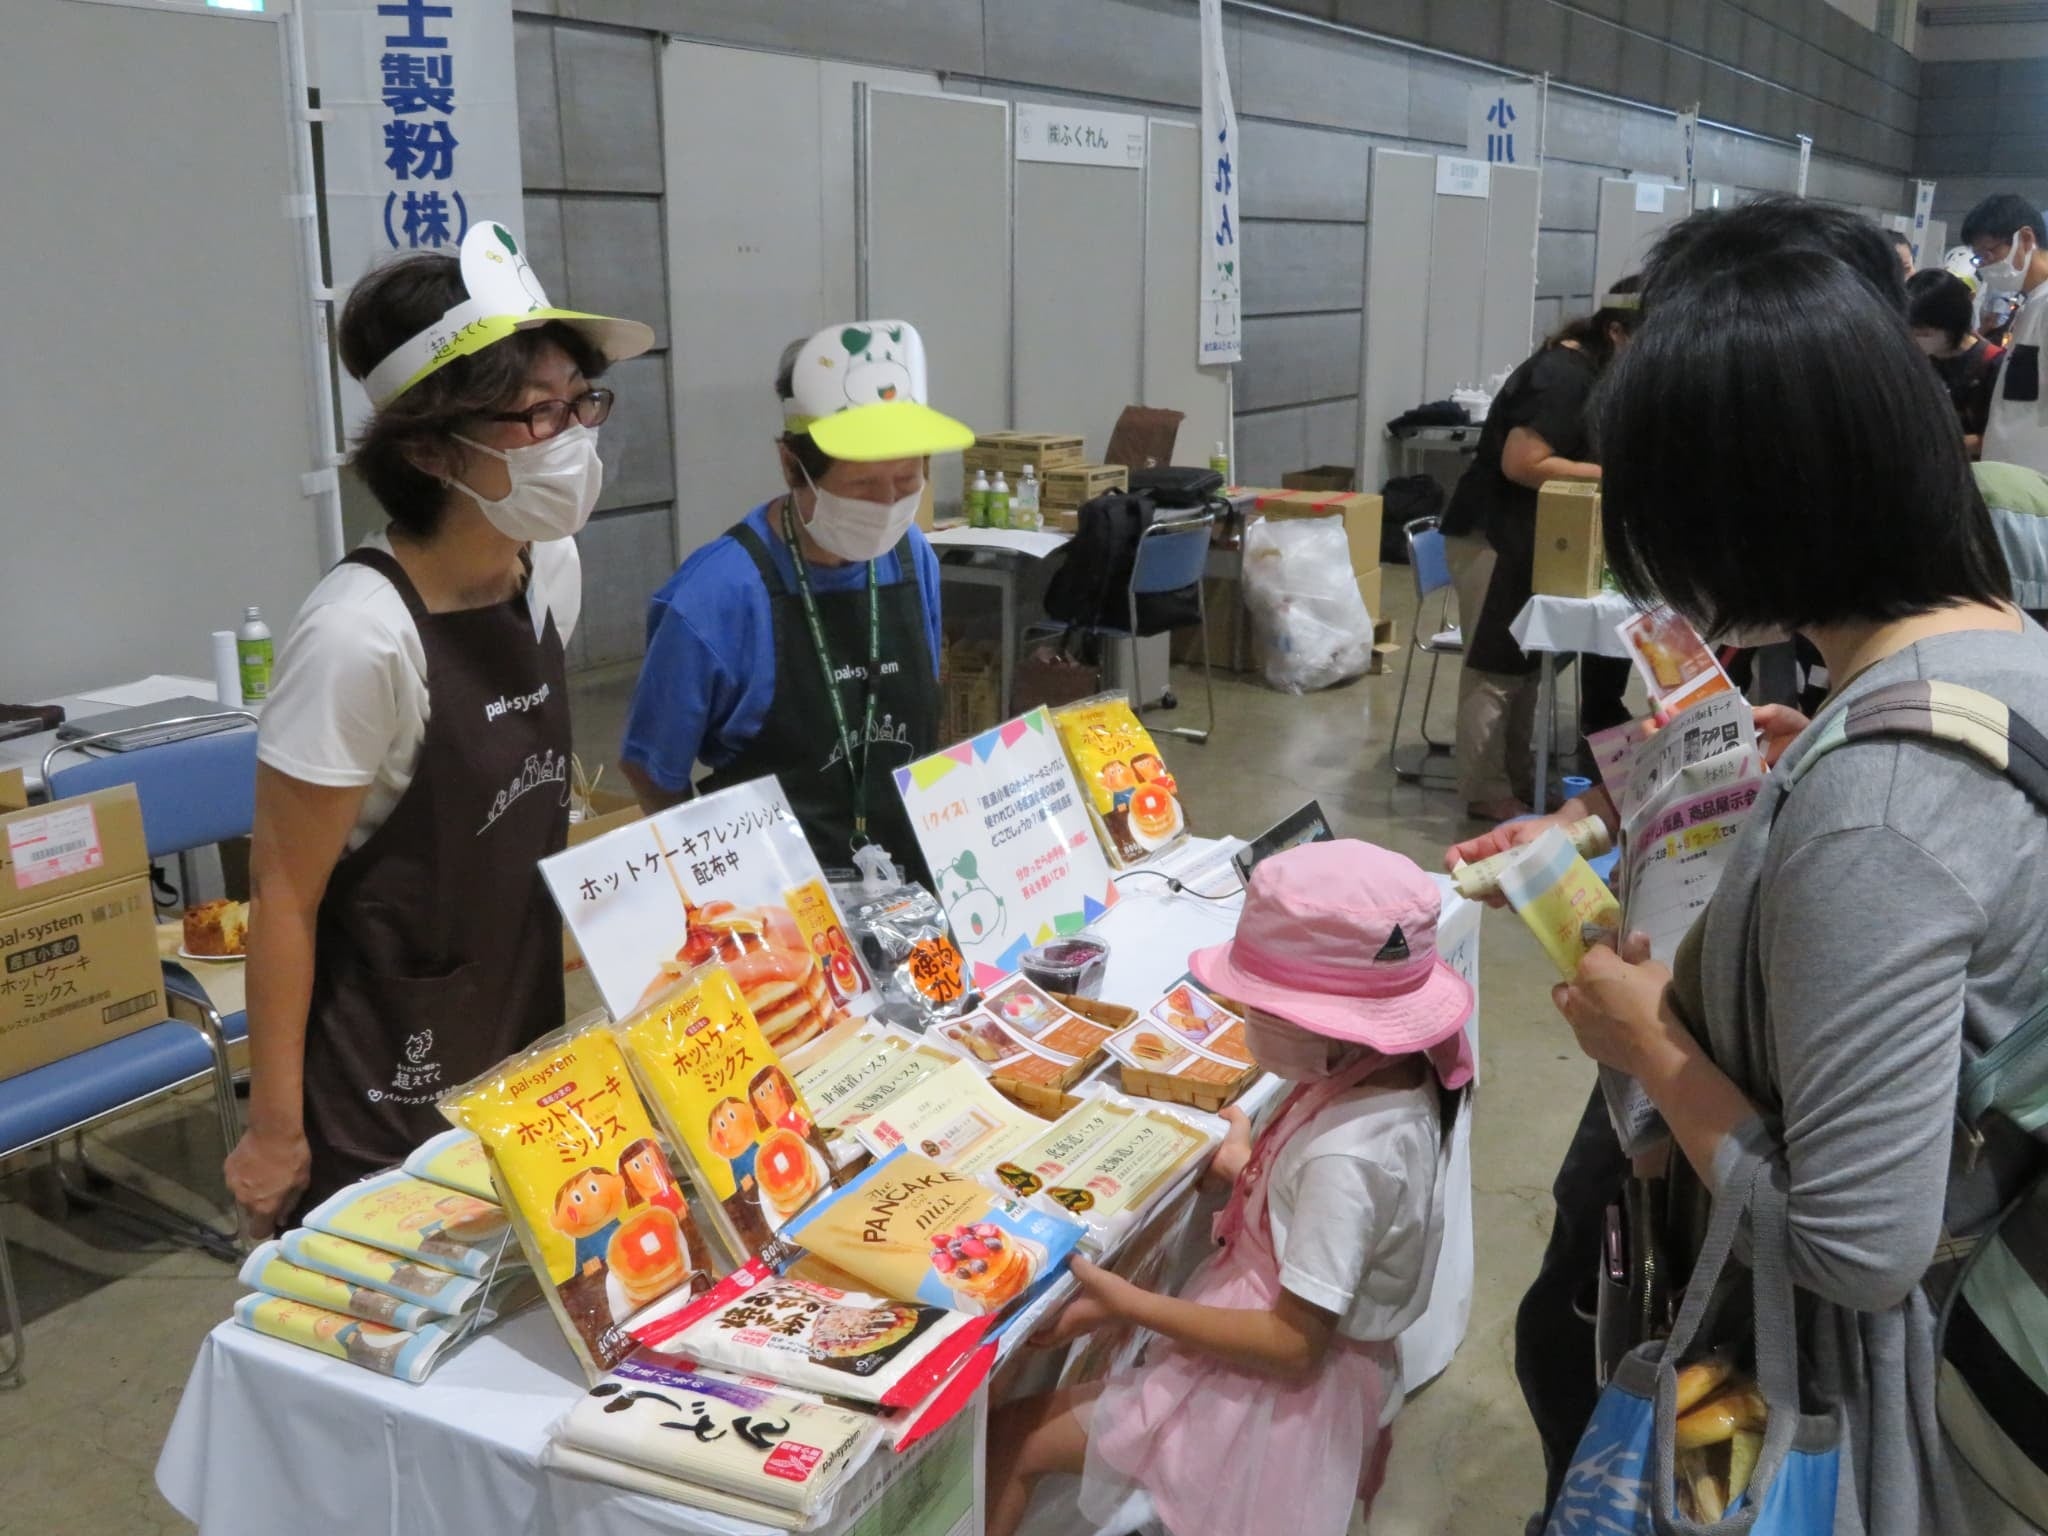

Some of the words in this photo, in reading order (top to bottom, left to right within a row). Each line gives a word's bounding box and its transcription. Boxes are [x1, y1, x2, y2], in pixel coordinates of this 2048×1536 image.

[1486, 97, 1517, 162] 小川
[691, 849, 742, 886] 配布中
[1, 955, 91, 995] ホットケーキ
[24, 980, 78, 1009] ミックス
[673, 1010, 747, 1077] ホットケーキ
[392, 1070, 442, 1091] 超えてく
[702, 1046, 754, 1093] ミックス
[517, 1075, 623, 1147] ホットケーキ
[556, 1114, 628, 1164] ミックス
[863, 1171, 965, 1243] PANCAKE
[915, 1194, 957, 1231] mix
